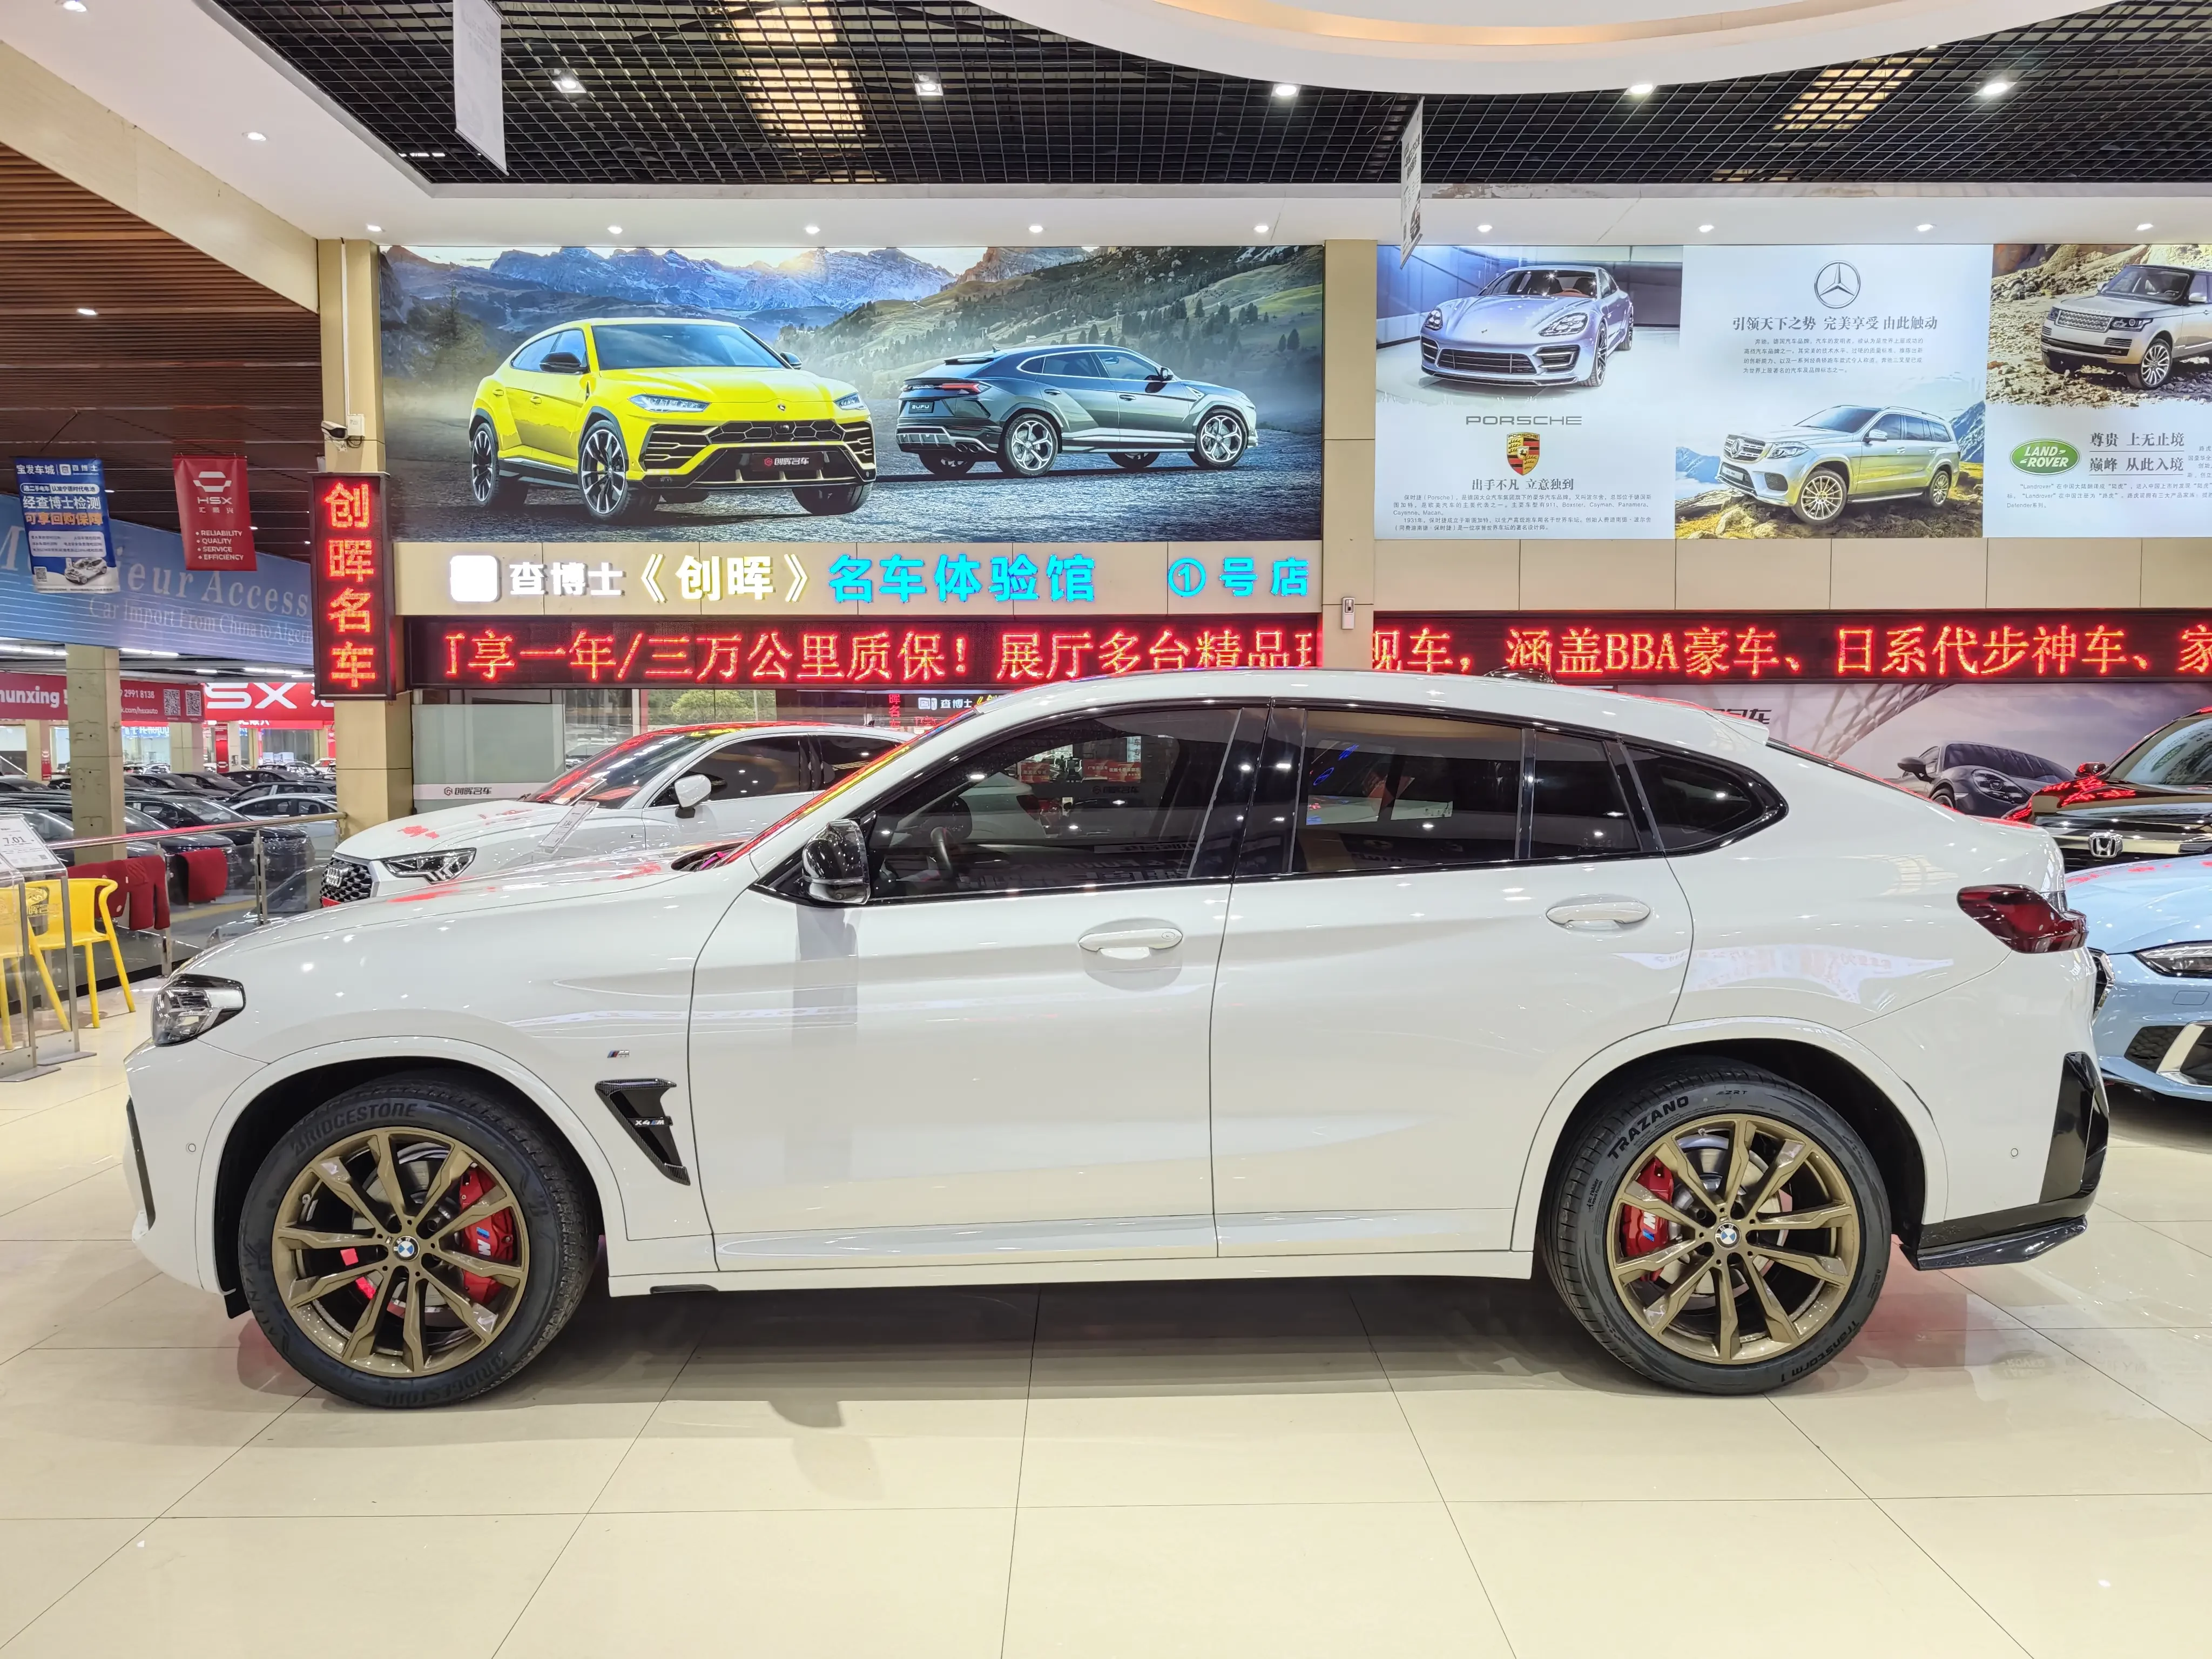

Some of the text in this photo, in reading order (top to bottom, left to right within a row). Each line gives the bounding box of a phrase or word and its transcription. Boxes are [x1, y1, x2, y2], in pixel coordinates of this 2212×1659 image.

[1732, 315, 1938, 331] 引领天下之势 完美享受 由此触动
[1466, 416, 1583, 426] PORSCHE
[2089, 432, 2184, 447] 尊贵 上无止境
[2024, 446, 2058, 456] LAND
[16, 464, 56, 475] 宝发车城
[2027, 457, 2069, 468] ROVER
[2089, 457, 2184, 472] 巅峰 从此入境
[1472, 478, 1574, 490] 出手不凡 立意独到
[22, 495, 102, 510] 经查博士检测
[197, 496, 233, 504] HSX
[24, 511, 104, 526] 可享回购保障
[325, 482, 376, 689] 创晖名车
[510, 562, 625, 596] 查博士
[642, 553, 808, 603] 《创晖》
[828, 554, 1096, 603] 名车体验馆
[201, 570, 308, 617] Access
[90, 596, 119, 619] Car
[123, 598, 174, 630] Import
[179, 608, 216, 633] From
[219, 613, 256, 637] China
[276, 621, 312, 646] Algeri
[940, 698, 973, 709] 查博士
[454, 787, 493, 795] 创晖名车
[291, 1102, 418, 1156] BRIDGESTONE
[1607, 1095, 1689, 1161] TRAZANO
